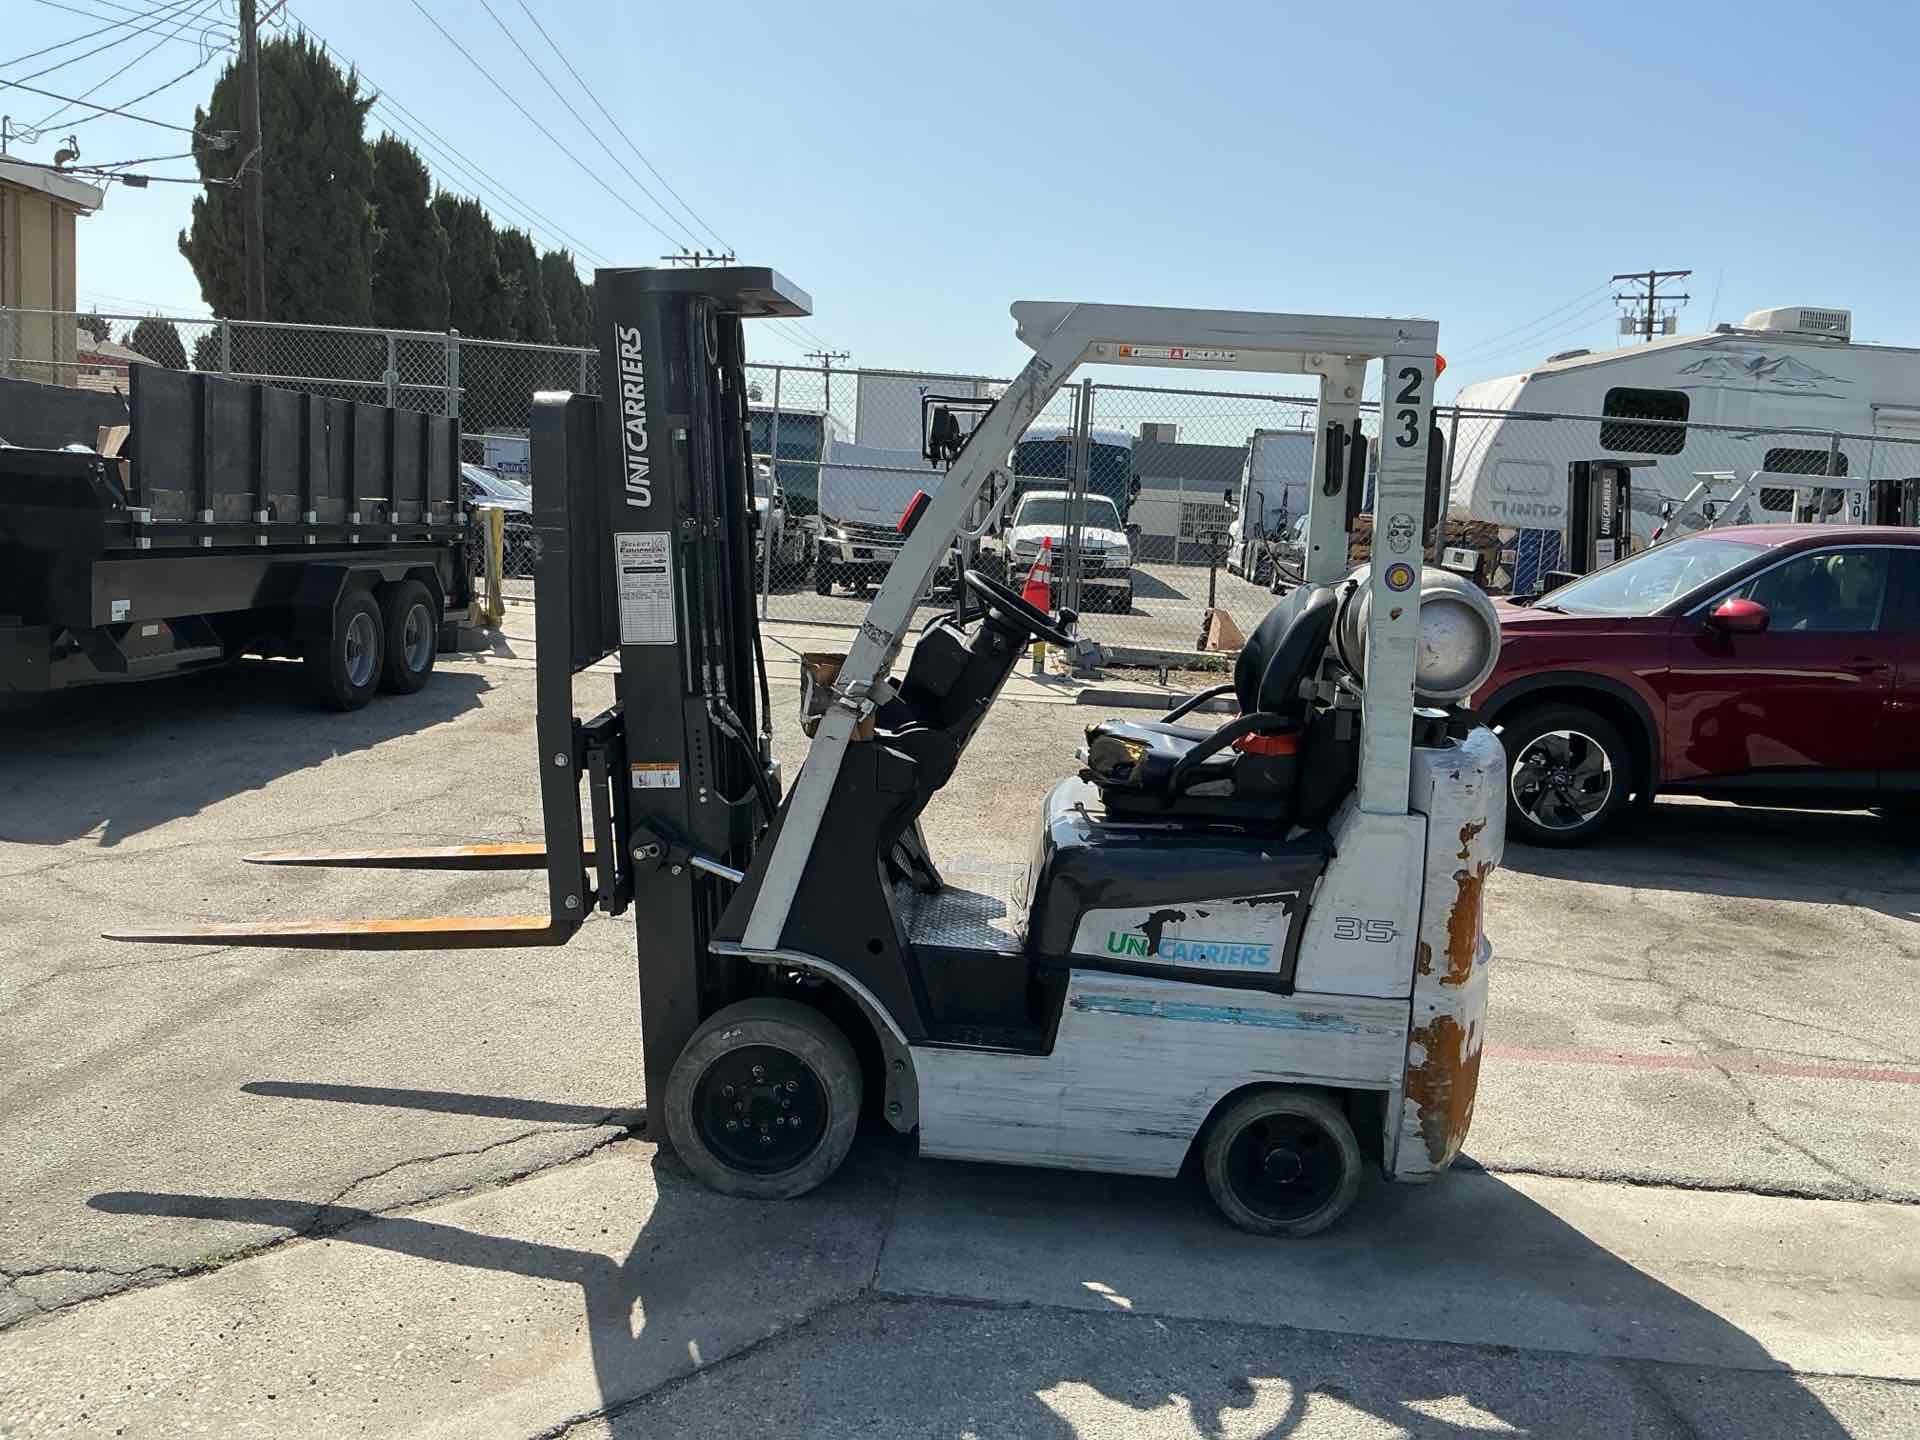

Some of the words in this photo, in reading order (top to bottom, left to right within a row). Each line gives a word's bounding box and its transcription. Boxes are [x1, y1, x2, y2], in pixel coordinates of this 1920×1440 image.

[619, 325, 652, 508] UNICARRIERS
[1334, 916, 1396, 943] 35
[1106, 930, 1271, 967] UNCARRIERS
